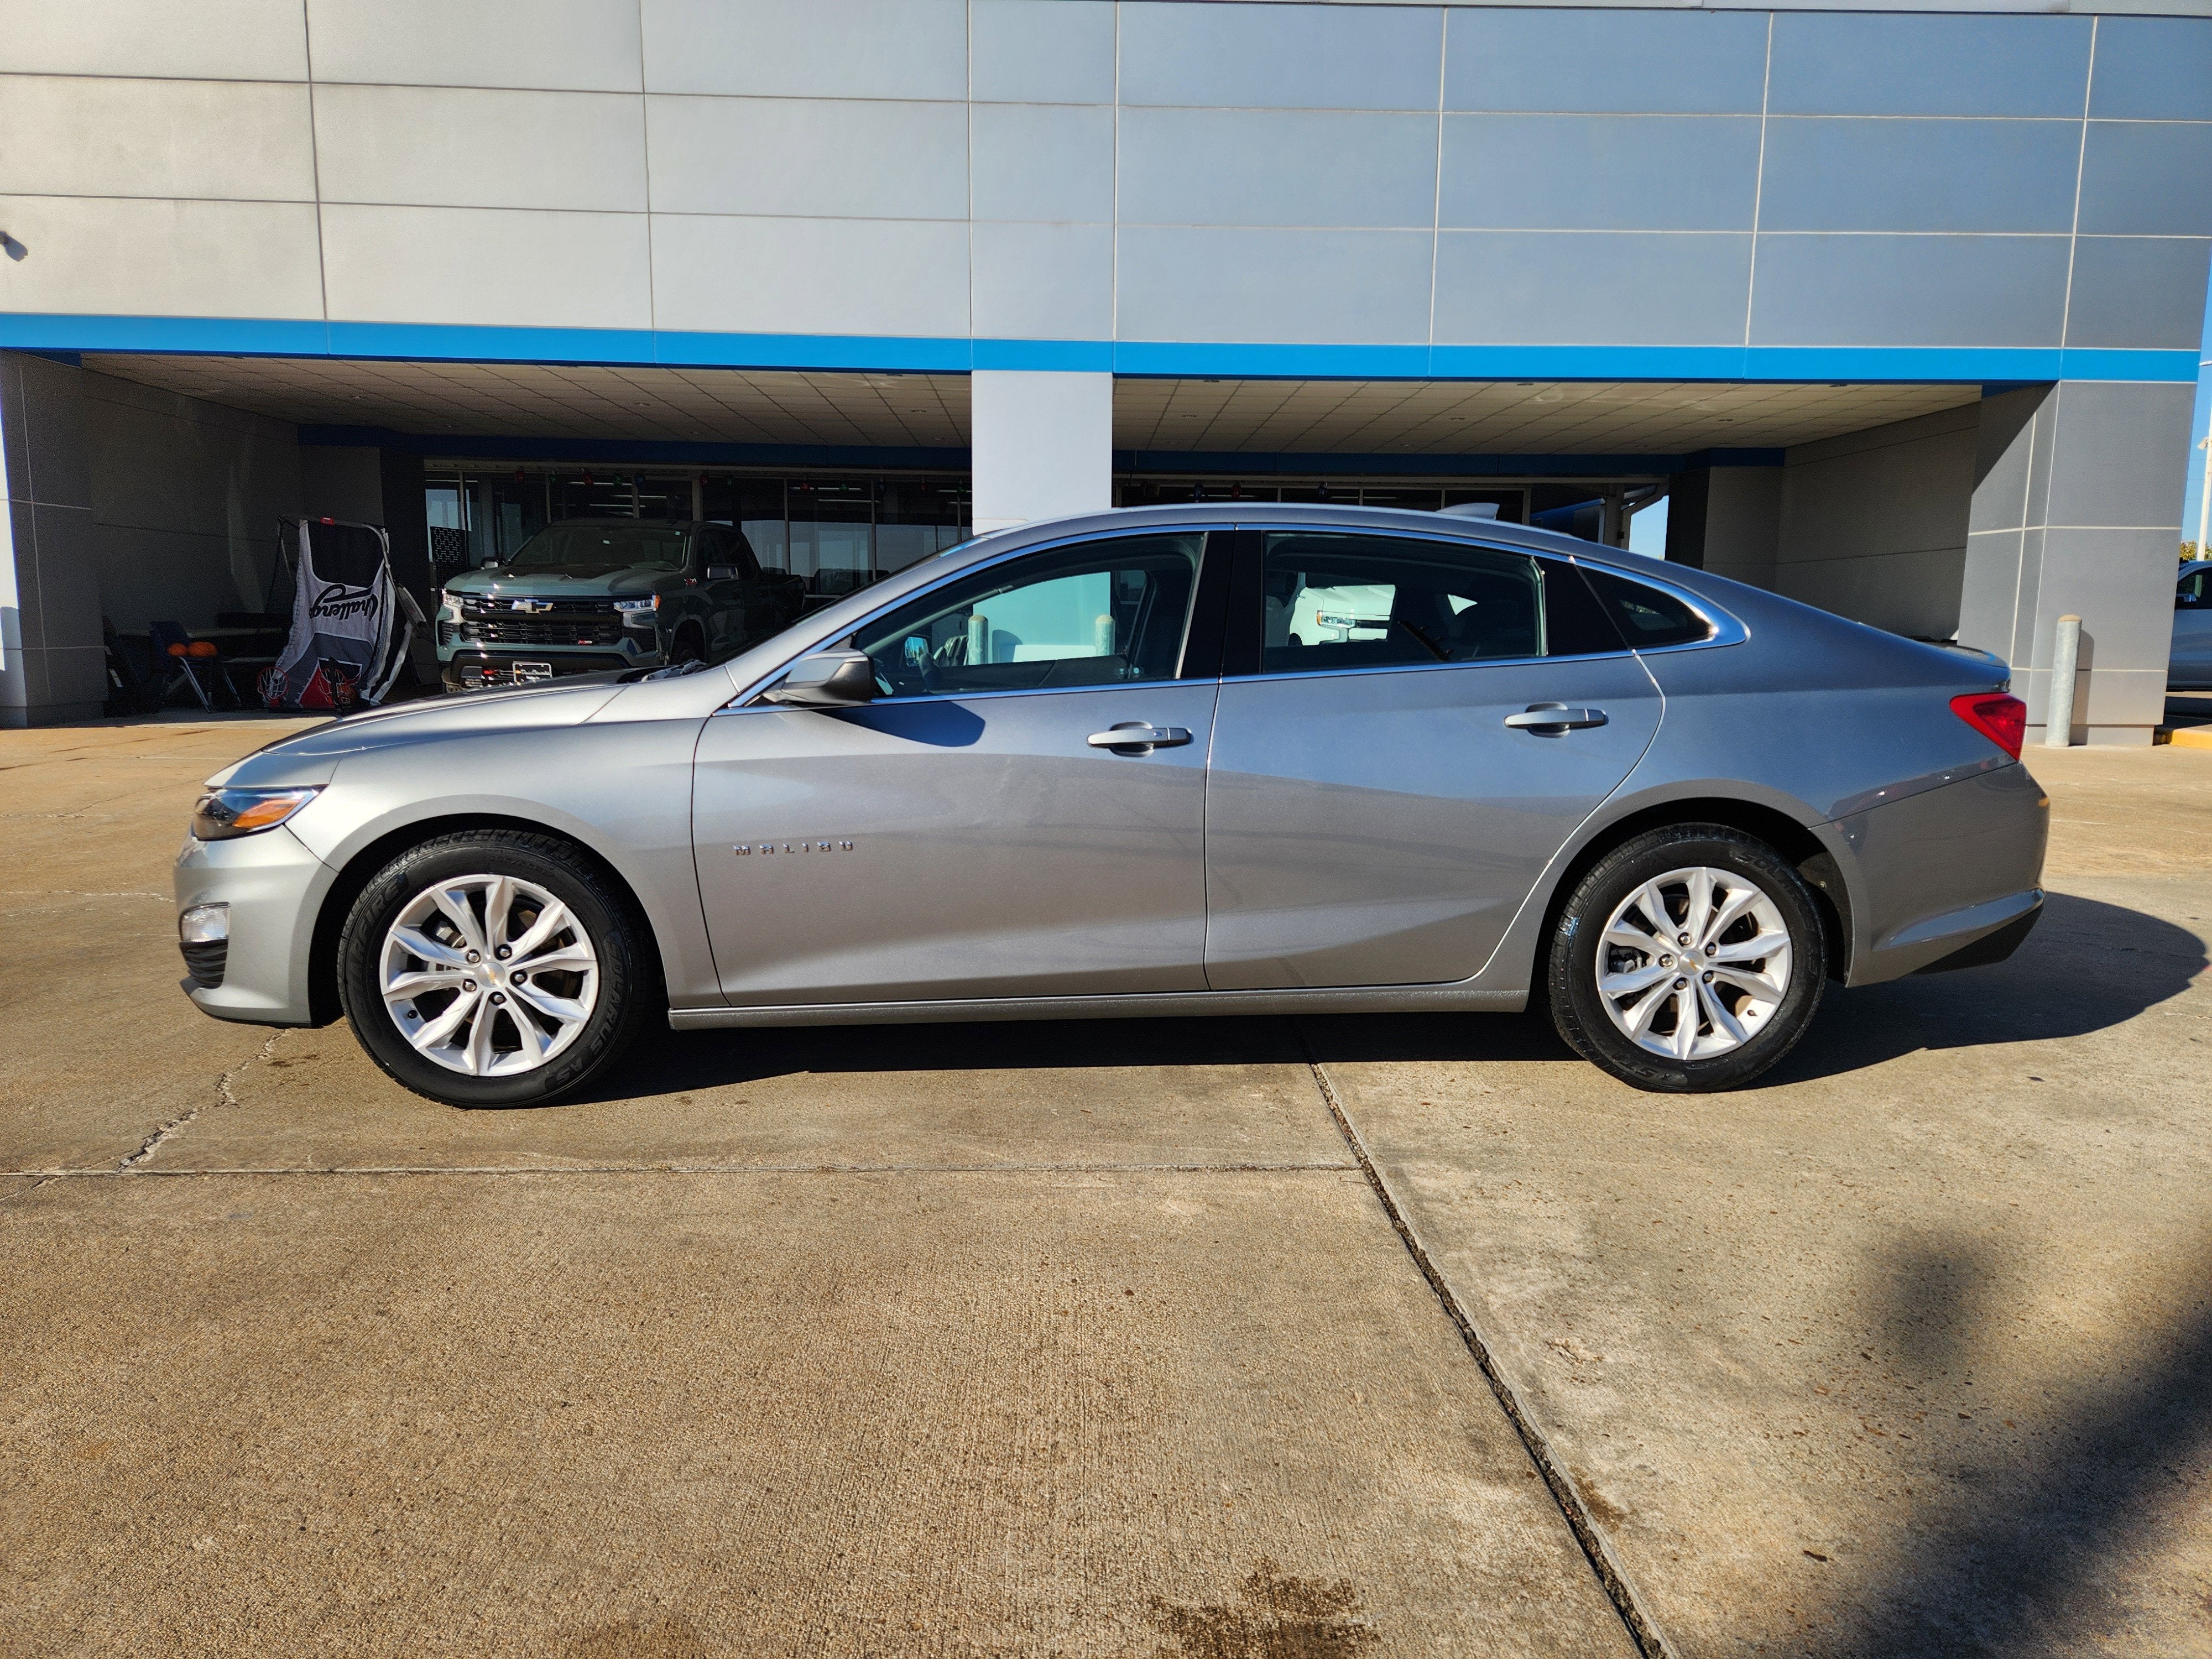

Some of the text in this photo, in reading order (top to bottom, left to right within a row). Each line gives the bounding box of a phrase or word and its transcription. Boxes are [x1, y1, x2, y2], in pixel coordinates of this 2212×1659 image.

[309, 585, 379, 622] Challeng
[733, 840, 854, 855] MALIBU
[554, 941, 625, 1086] SOLARUS AS
